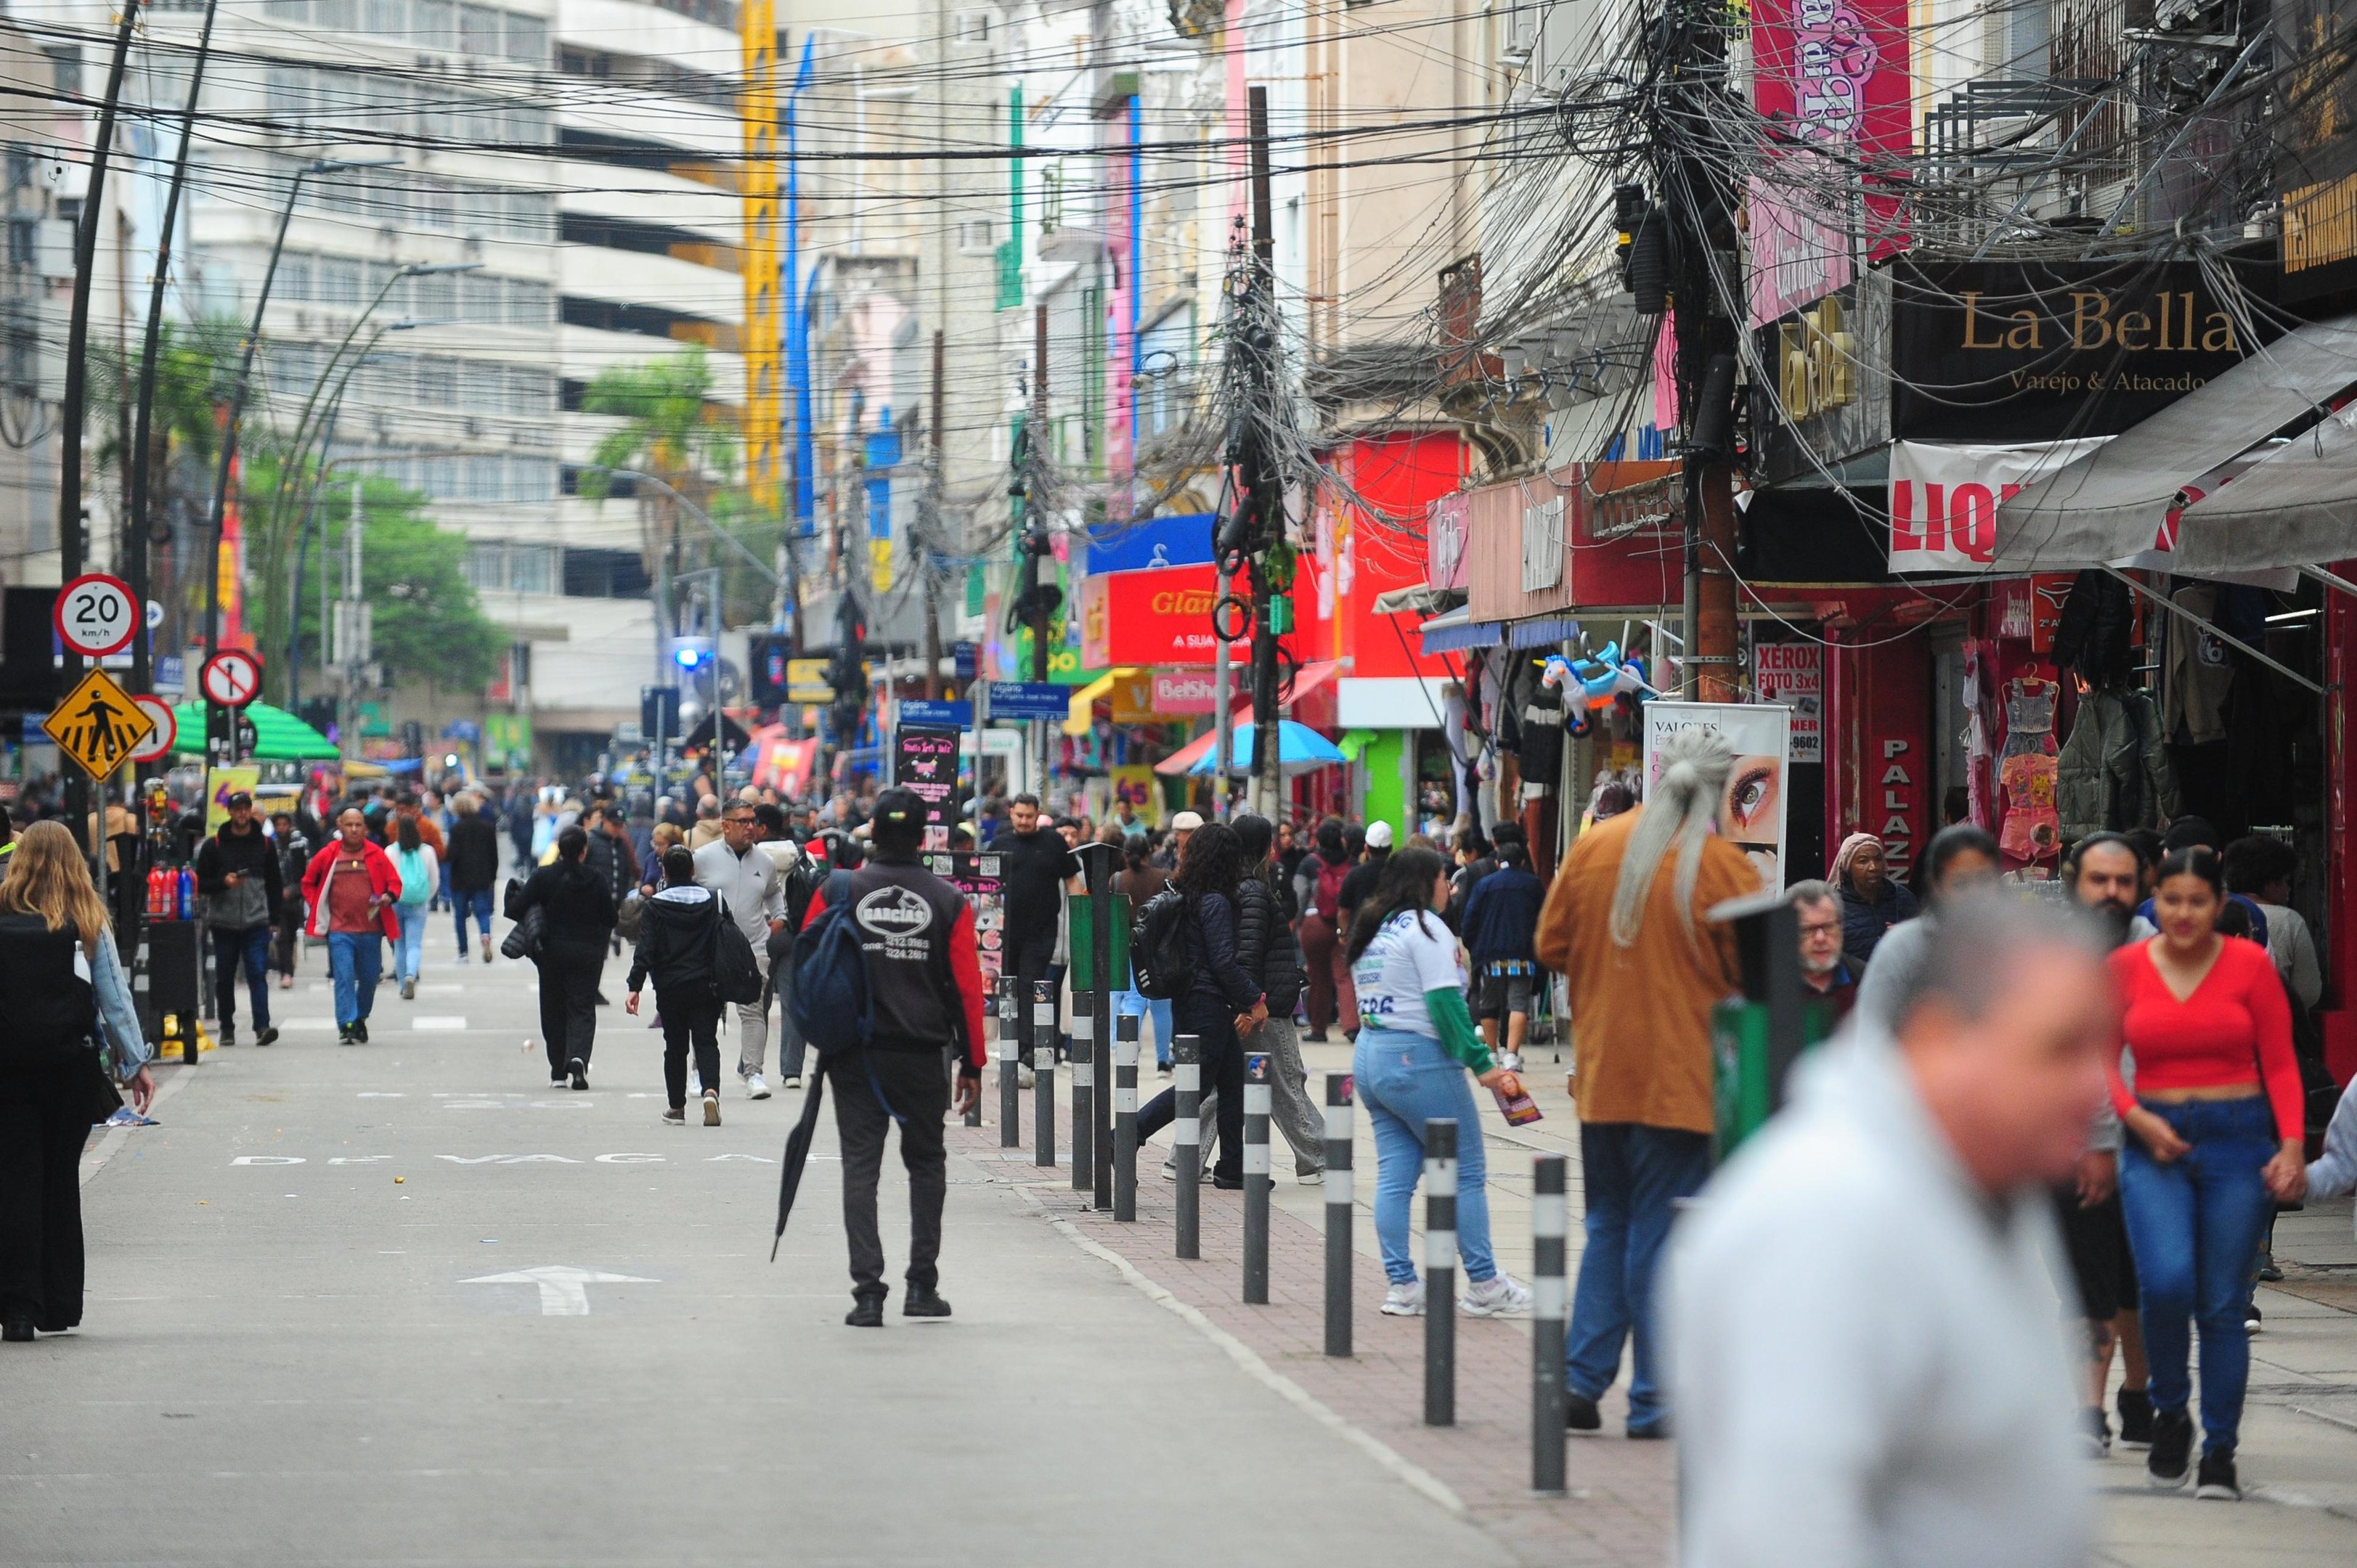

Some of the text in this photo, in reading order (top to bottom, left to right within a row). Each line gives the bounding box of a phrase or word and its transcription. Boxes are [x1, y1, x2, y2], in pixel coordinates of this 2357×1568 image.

[1961, 290, 2238, 351] La Bella
[2010, 371, 2205, 396] Varejo & Atacado
[76, 594, 119, 623] 20
[1758, 646, 1820, 669] XEROX
[1758, 673, 1820, 689] FOTO 3x4
